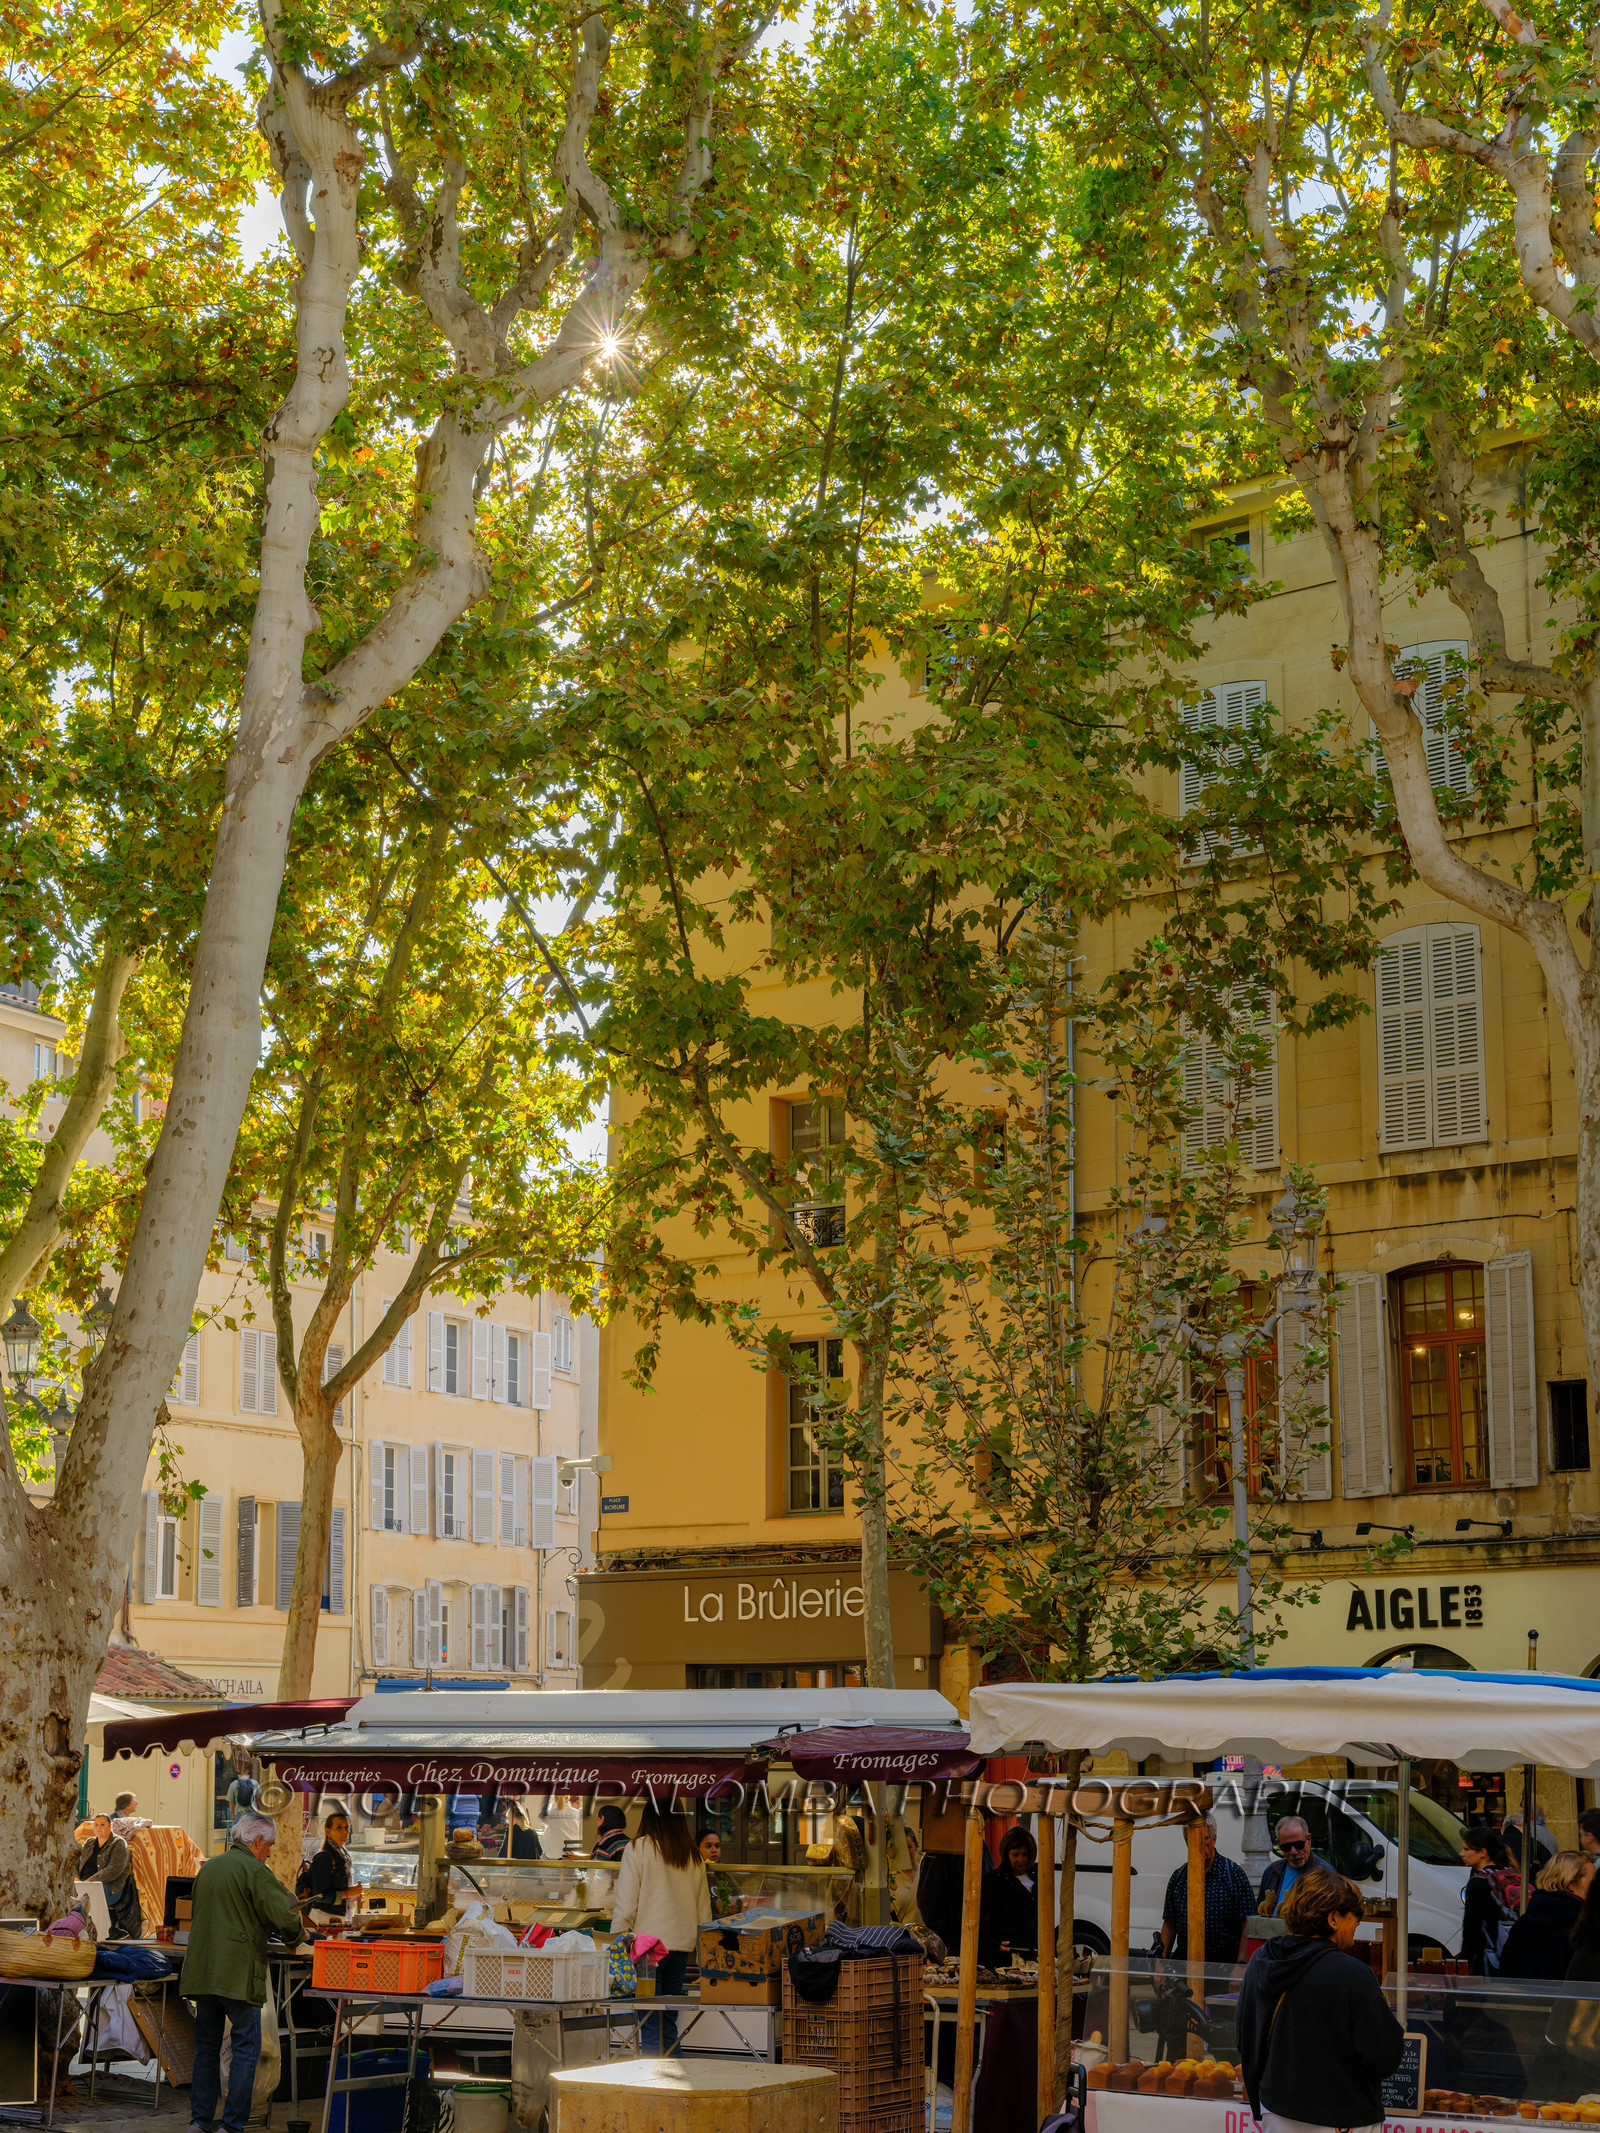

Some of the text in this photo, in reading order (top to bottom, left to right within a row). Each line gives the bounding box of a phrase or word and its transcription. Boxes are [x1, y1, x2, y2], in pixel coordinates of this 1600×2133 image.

[684, 1578, 865, 1622] La Brûlerie
[1346, 1586, 1462, 1630] AIGLE
[1464, 1584, 1483, 1627] 1853
[282, 1760, 717, 1790] Charcuteries Chez Dominique Fromages
[833, 1752, 939, 1774] Fromages
